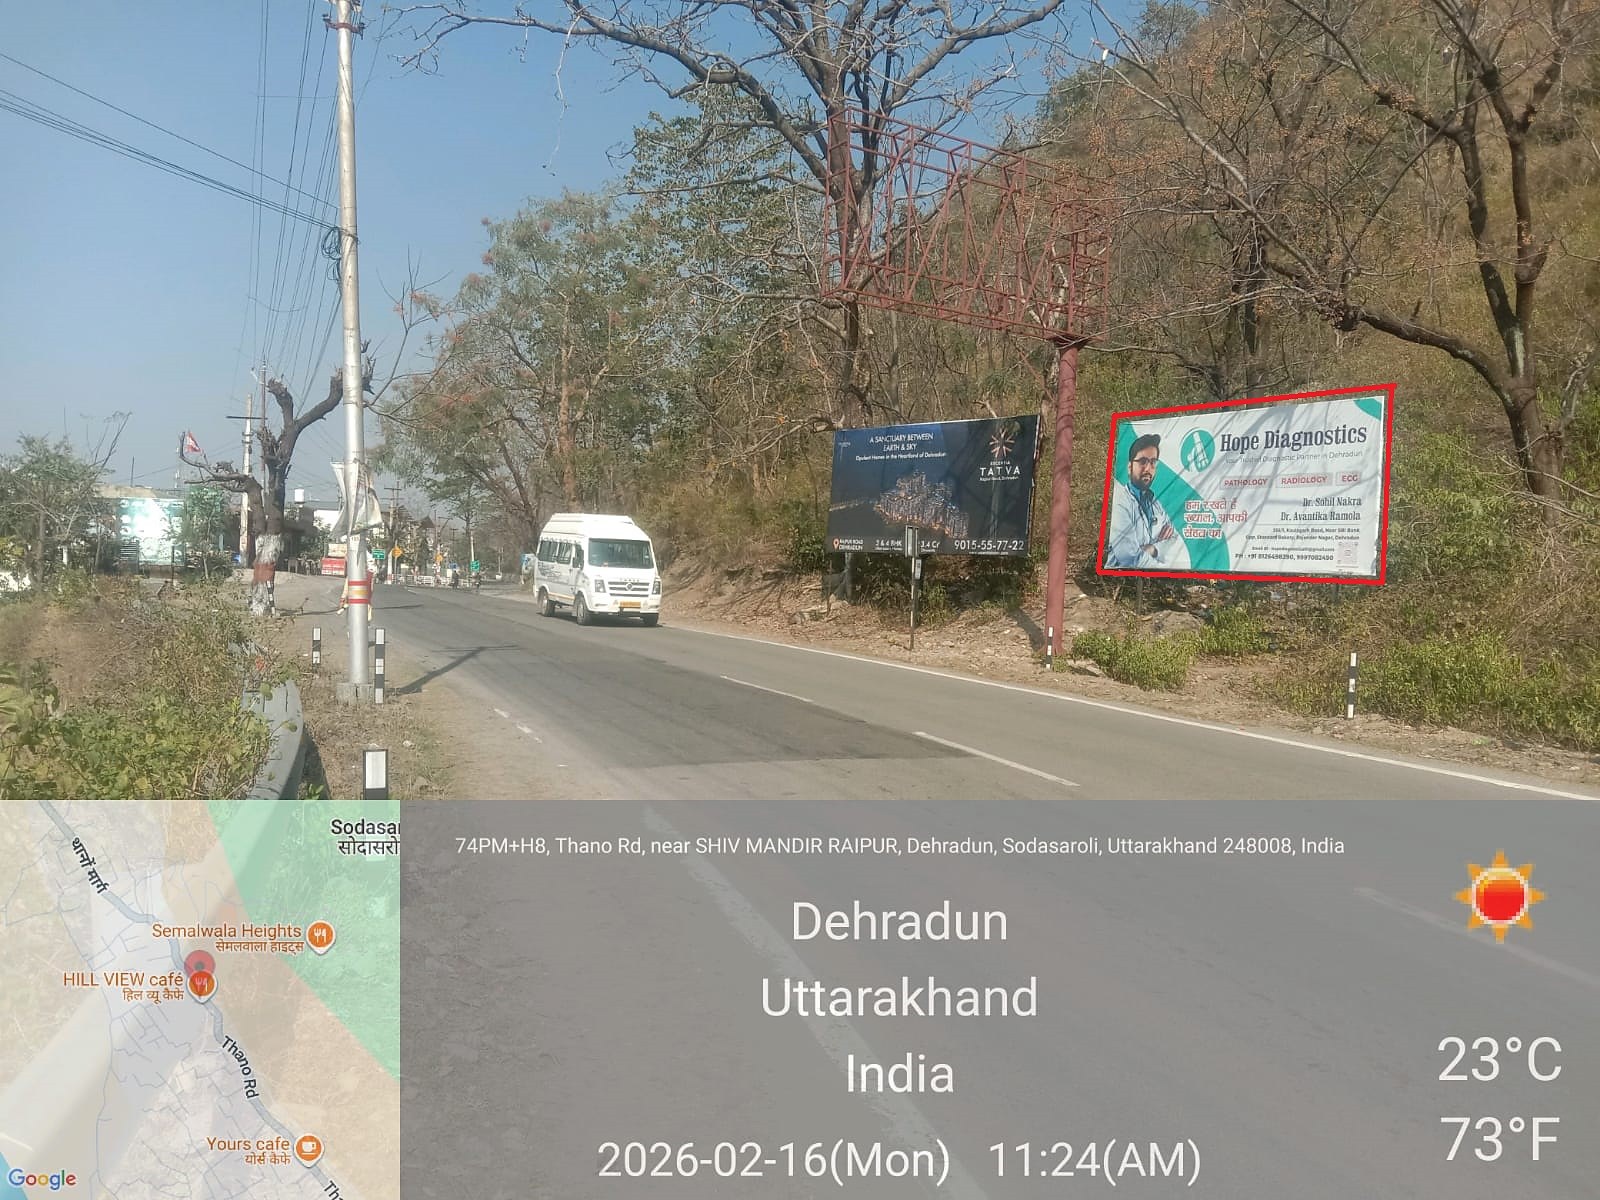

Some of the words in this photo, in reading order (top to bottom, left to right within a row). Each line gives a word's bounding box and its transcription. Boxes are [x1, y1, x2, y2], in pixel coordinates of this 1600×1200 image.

[875, 435, 906, 443] SANCTUARY
[907, 433, 934, 441] BETWEEN
[1220, 434, 1259, 453] Hope
[1264, 424, 1367, 451] Diagnostics
[980, 466, 1020, 476] TATVA
[1224, 478, 1268, 487] PATHOLOGY
[1281, 475, 1328, 485] RADIOLOGY
[1303, 498, 1313, 506] Dr.
[1337, 497, 1361, 506] Nakra
[1281, 512, 1291, 520] Dr.
[1293, 512, 1327, 520] Avantika
[1330, 511, 1360, 520] Ramola
[954, 540, 1025, 551] 9015-55-77-22
